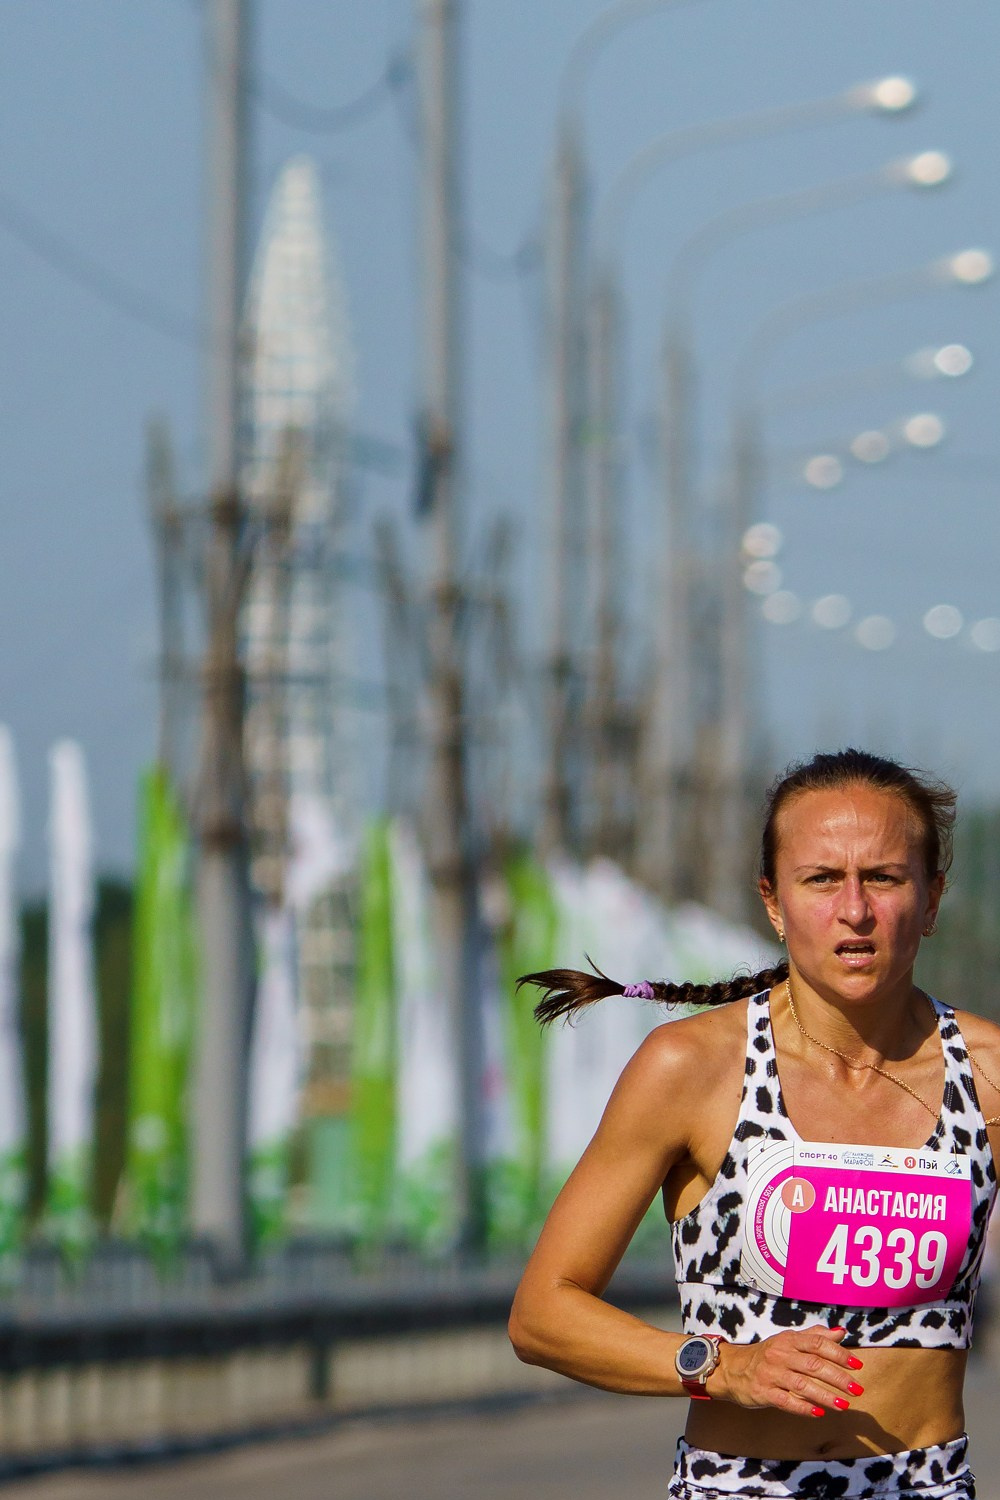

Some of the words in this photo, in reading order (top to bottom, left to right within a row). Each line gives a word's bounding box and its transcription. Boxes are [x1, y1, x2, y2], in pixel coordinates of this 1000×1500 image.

[799, 1152, 827, 1160] СПОРТ
[919, 1158, 938, 1170] Пэй
[792, 1184, 804, 1206] А
[824, 1187, 947, 1221] АНАСТАСИЯ
[816, 1224, 948, 1289] 4339
